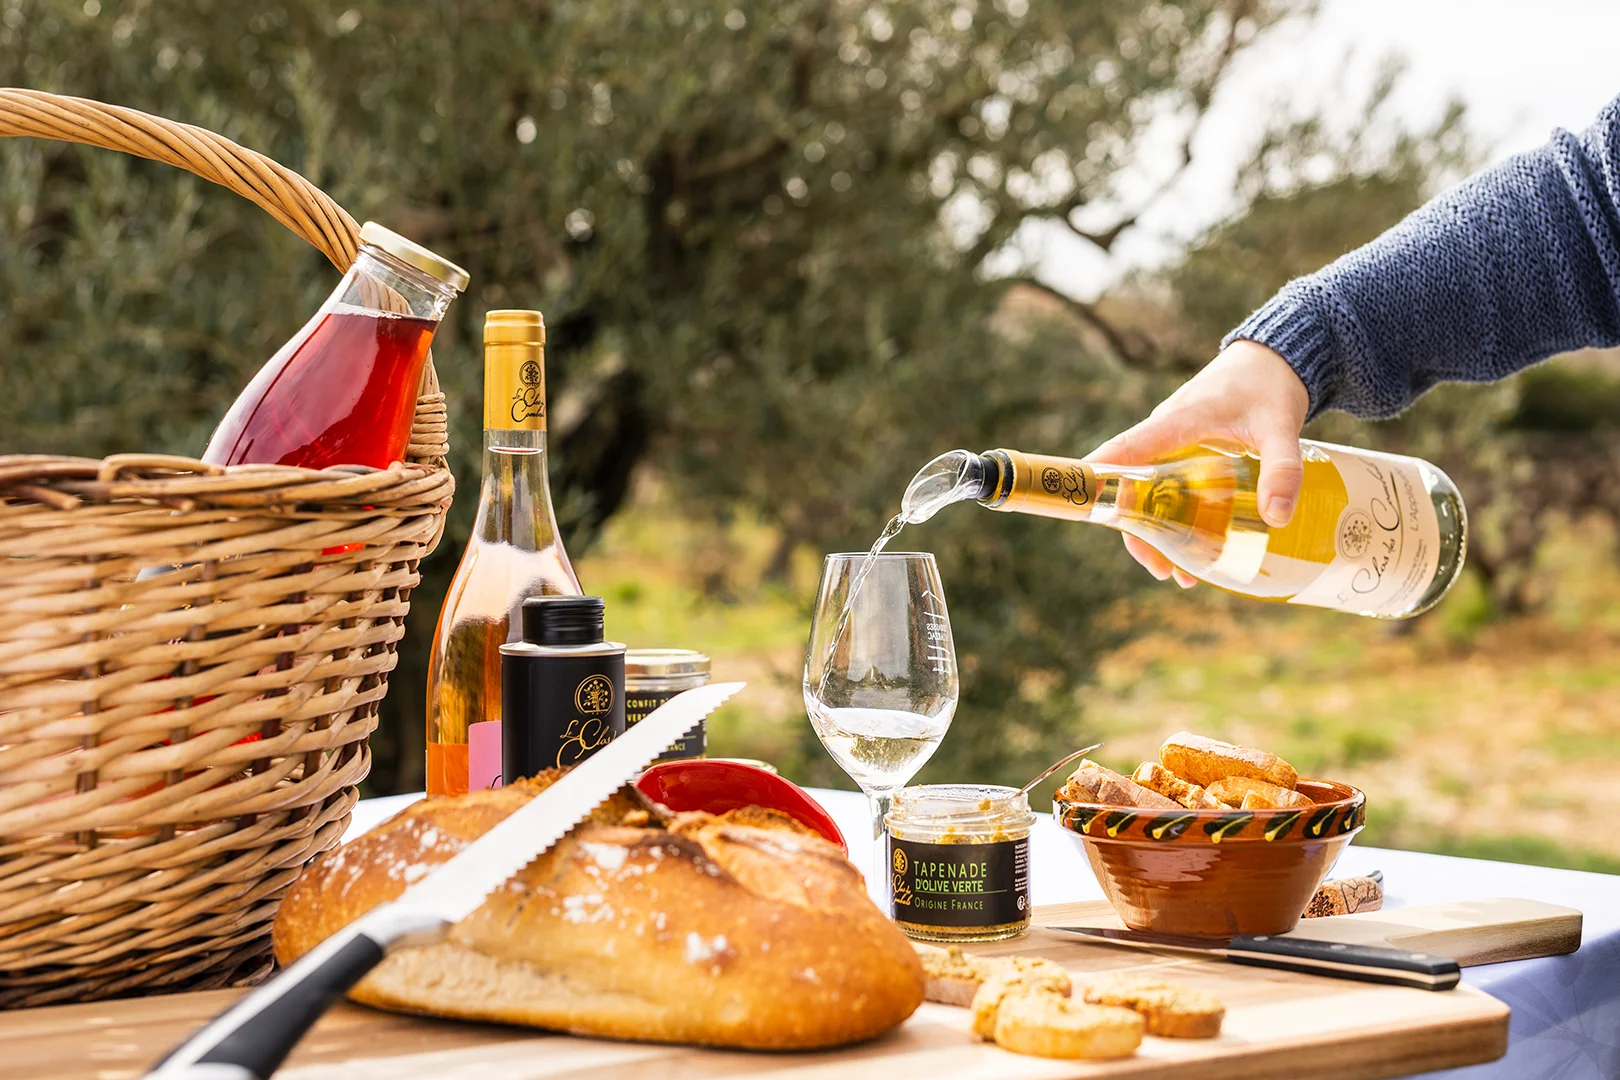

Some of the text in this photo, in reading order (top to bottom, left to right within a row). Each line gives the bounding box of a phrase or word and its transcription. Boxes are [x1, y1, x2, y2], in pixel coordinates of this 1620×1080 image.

[1351, 556, 1390, 594] Clos
[626, 699, 657, 708] CONFIT
[579, 718, 611, 750] Clos
[913, 860, 987, 878] TAPENADE
[915, 880, 984, 893] D'OLIVE VERTE
